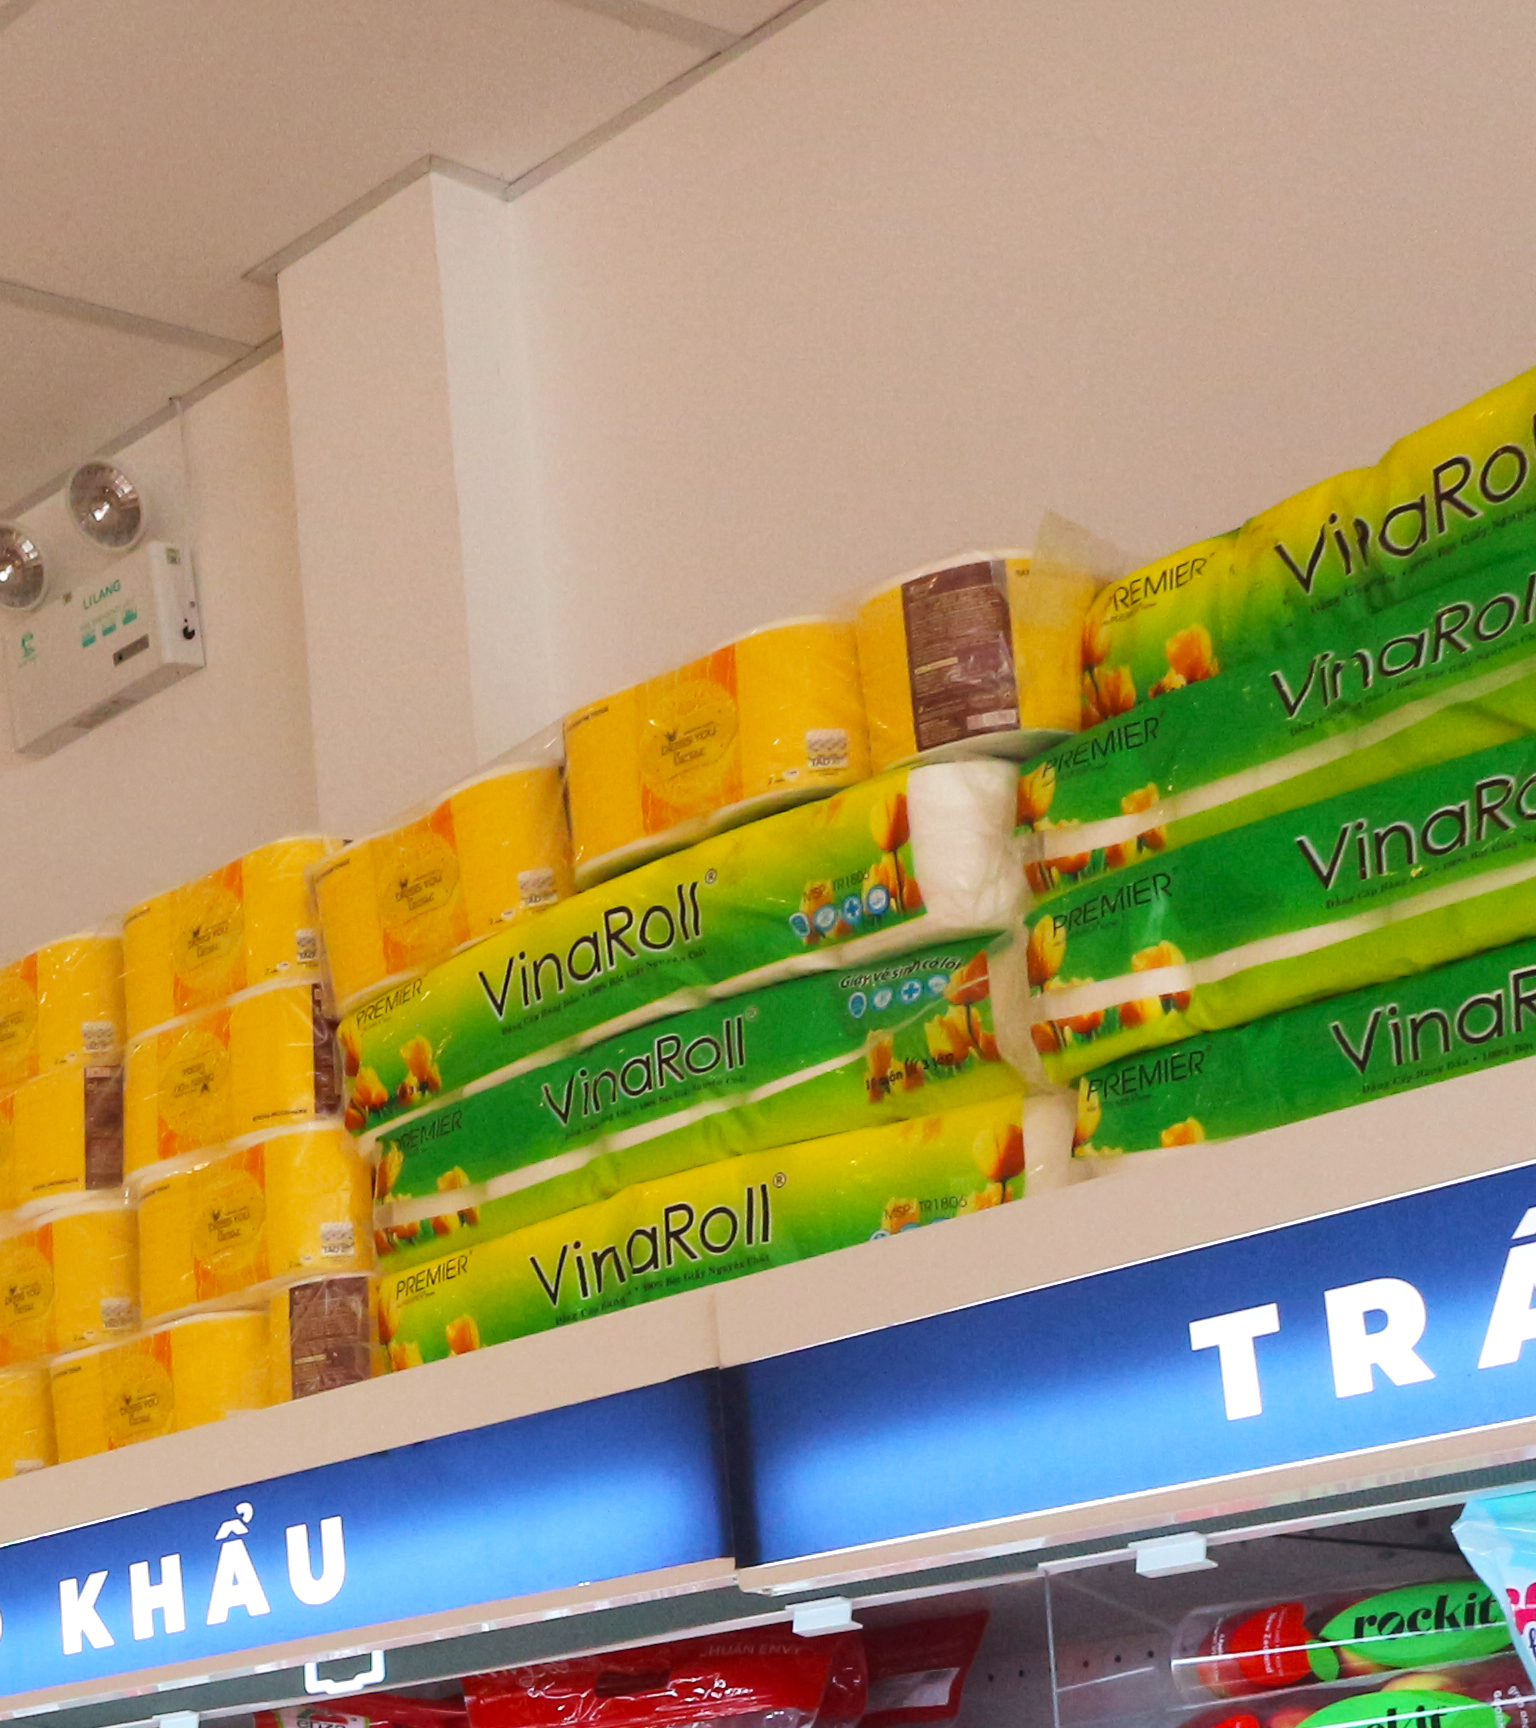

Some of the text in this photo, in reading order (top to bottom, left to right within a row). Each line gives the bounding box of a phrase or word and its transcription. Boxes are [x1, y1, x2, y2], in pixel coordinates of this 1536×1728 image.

[1275, 432, 1536, 595] VinaRo
[1042, 718, 1159, 777] PREMIER
[1054, 873, 1172, 937] PREMIER
[478, 881, 702, 1020] VinaRoll
[356, 978, 423, 1026] PREMIER
[543, 1015, 745, 1126] VinaRoll
[1088, 1051, 1205, 1101] PREMIER
[530, 1184, 772, 1306] VinaRoll
[396, 1260, 468, 1299] PREMIER
[58, 1501, 348, 1657] KHẨU
[1354, 1592, 1498, 1643] rockit
